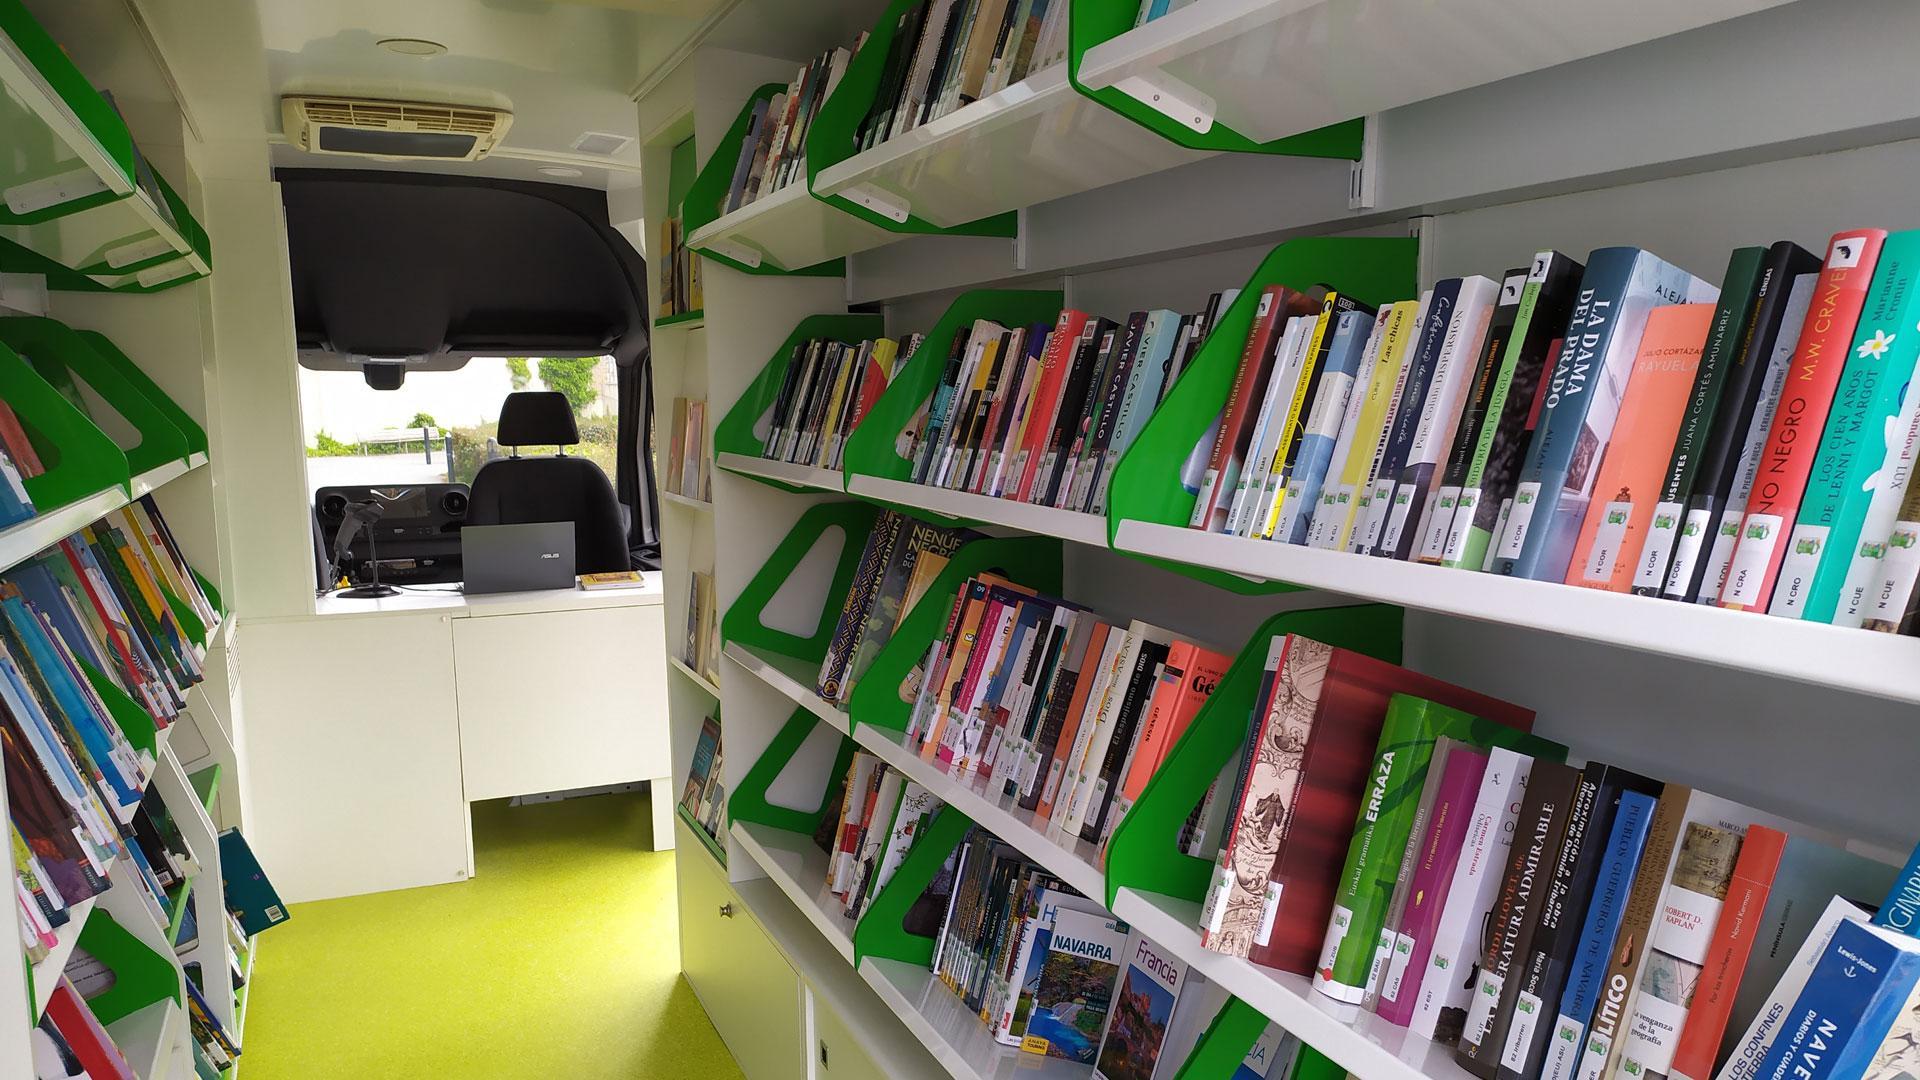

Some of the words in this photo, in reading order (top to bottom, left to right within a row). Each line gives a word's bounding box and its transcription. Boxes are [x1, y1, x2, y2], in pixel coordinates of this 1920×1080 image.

[1757, 266, 1774, 297] CENIZAS
[1872, 258, 1899, 322] Marianne
[1569, 285, 1595, 332] DEL
[1586, 296, 1610, 330] LA
[1884, 275, 1907, 322] Cronin
[1386, 308, 1404, 343] chicas
[1117, 322, 1137, 369] JAVIER
[1136, 335, 1150, 367] VIER
[1380, 343, 1393, 363] Las
[1801, 337, 1824, 382] M.W.
[1414, 422, 1429, 449] Pepe
[1432, 308, 1466, 384] DISPERSIÓN
[1545, 332, 1579, 410] PRADO
[1562, 328, 1600, 400] DAMA
[1682, 416, 1698, 450] JUANA
[1691, 371, 1712, 414] CORTÉS
[1705, 307, 1732, 369] AMUNARRIZ
[1491, 367, 1512, 409] JUNGLA
[1849, 367, 1878, 433] MARGOT
[1096, 373, 1122, 439] CASTILLO
[1114, 372, 1139, 440] CASTILLO
[1768, 394, 1807, 476] NEGRO
[1818, 454, 1836, 482] LOS
[1828, 413, 1849, 450] CIEN
[1840, 367, 1864, 408] AÑOS
[1844, 437, 1855, 449] Y
[1741, 467, 1754, 489] PIEDRA
[1828, 451, 1851, 500] LENNI
[1890, 466, 1908, 489] LUX
[1738, 489, 1747, 499] DE
[1820, 503, 1835, 524] DE
[1596, 549, 1607, 566] COR
[1646, 550, 1658, 568] COR
[1671, 559, 1682, 579] COR
[1735, 568, 1747, 588] CRA
[1788, 576, 1801, 597] CRO
[1879, 578, 1895, 600] CUE
[1849, 585, 1864, 606] CUE
[846, 613, 869, 665] NEGRO
[1115, 634, 1134, 674] ASLAN
[1135, 651, 1149, 671] DIOS
[1131, 671, 1141, 684] de
[1113, 685, 1139, 734] espejismo
[1111, 734, 1120, 745] El
[1363, 749, 1397, 822] ERRAZA
[1572, 781, 1590, 822] literaria
[1408, 807, 1426, 840] literatura
[1475, 815, 1493, 846] Carmen
[1567, 782, 1597, 863] Aproximación
[1568, 823, 1577, 837] de
[1615, 803, 1640, 857] PUEBLOS
[1354, 823, 1376, 866] gramatika
[1404, 847, 1413, 858] de
[1407, 840, 1415, 848] la
[1517, 800, 1554, 901] ADMIRABLE
[1555, 838, 1573, 879] Damián
[1396, 858, 1412, 882] Elogio
[1465, 846, 1484, 876] Estrada
[1347, 867, 1363, 896] Euskal
[1559, 884, 1568, 895] la
[1541, 879, 1561, 926] Iribarren
[1592, 861, 1623, 934] GUERREROS
[1736, 888, 1754, 917] Kermani
[1549, 902, 1562, 929] obra
[1666, 914, 1694, 930] KAPLAN
[1729, 916, 1744, 939] Navid
[1054, 933, 1112, 961] NAVARRA
[1532, 950, 1547, 974] María
[1587, 939, 1600, 956] DE
[1837, 945, 1878, 973] Lewis-Jones
[1136, 940, 1178, 986] Francia
[1568, 960, 1594, 1018] NAVARRA
[1512, 1023, 1526, 1052] Iribarren
[1629, 1026, 1662, 1048] geografía
[1637, 1021, 1647, 1031] de
[1646, 1025, 1656, 1035] la
[1638, 1011, 1673, 1034] venganza
[1794, 1009, 1816, 1045] DIARIOS
[1558, 1046, 1566, 1061] ASU
[1728, 1058, 1748, 1080] LOS
[1744, 1002, 1784, 1059] CONFINES
[1790, 1044, 1798, 1052] Y
